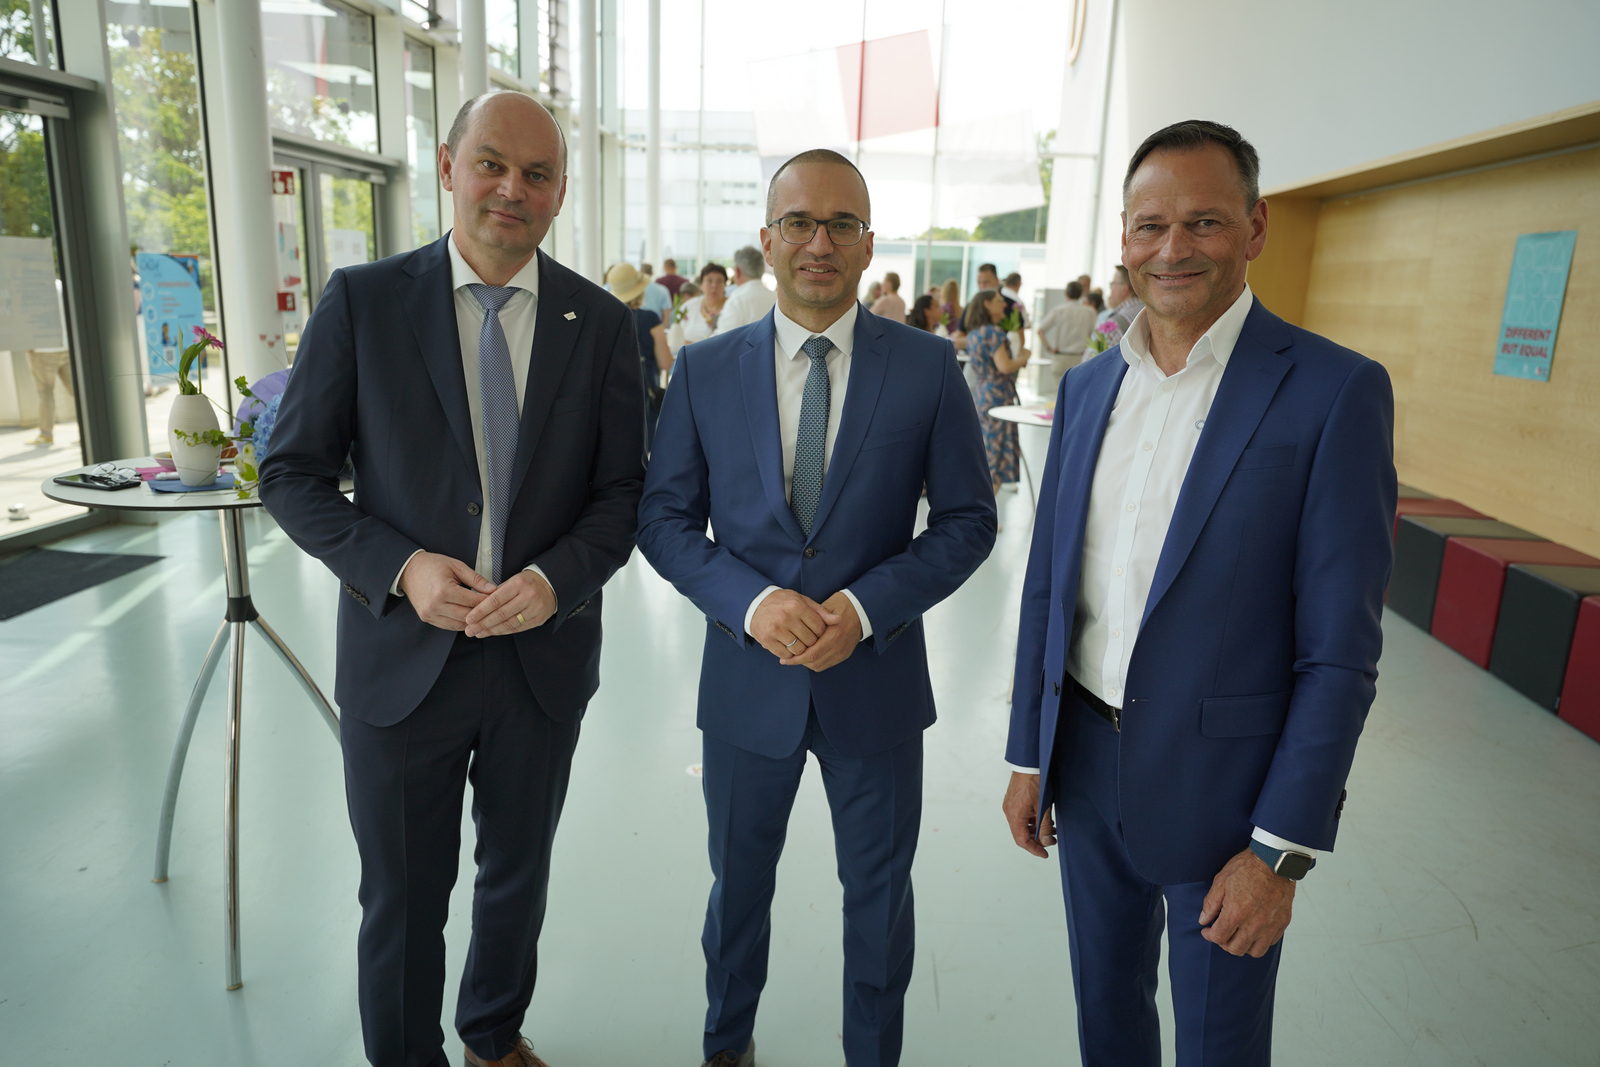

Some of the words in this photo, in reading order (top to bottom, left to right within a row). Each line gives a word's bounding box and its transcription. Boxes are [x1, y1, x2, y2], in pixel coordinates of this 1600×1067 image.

[1505, 326, 1552, 341] DIFFERENT
[1501, 342, 1518, 354] BUT
[1519, 344, 1549, 358] EQUAL
